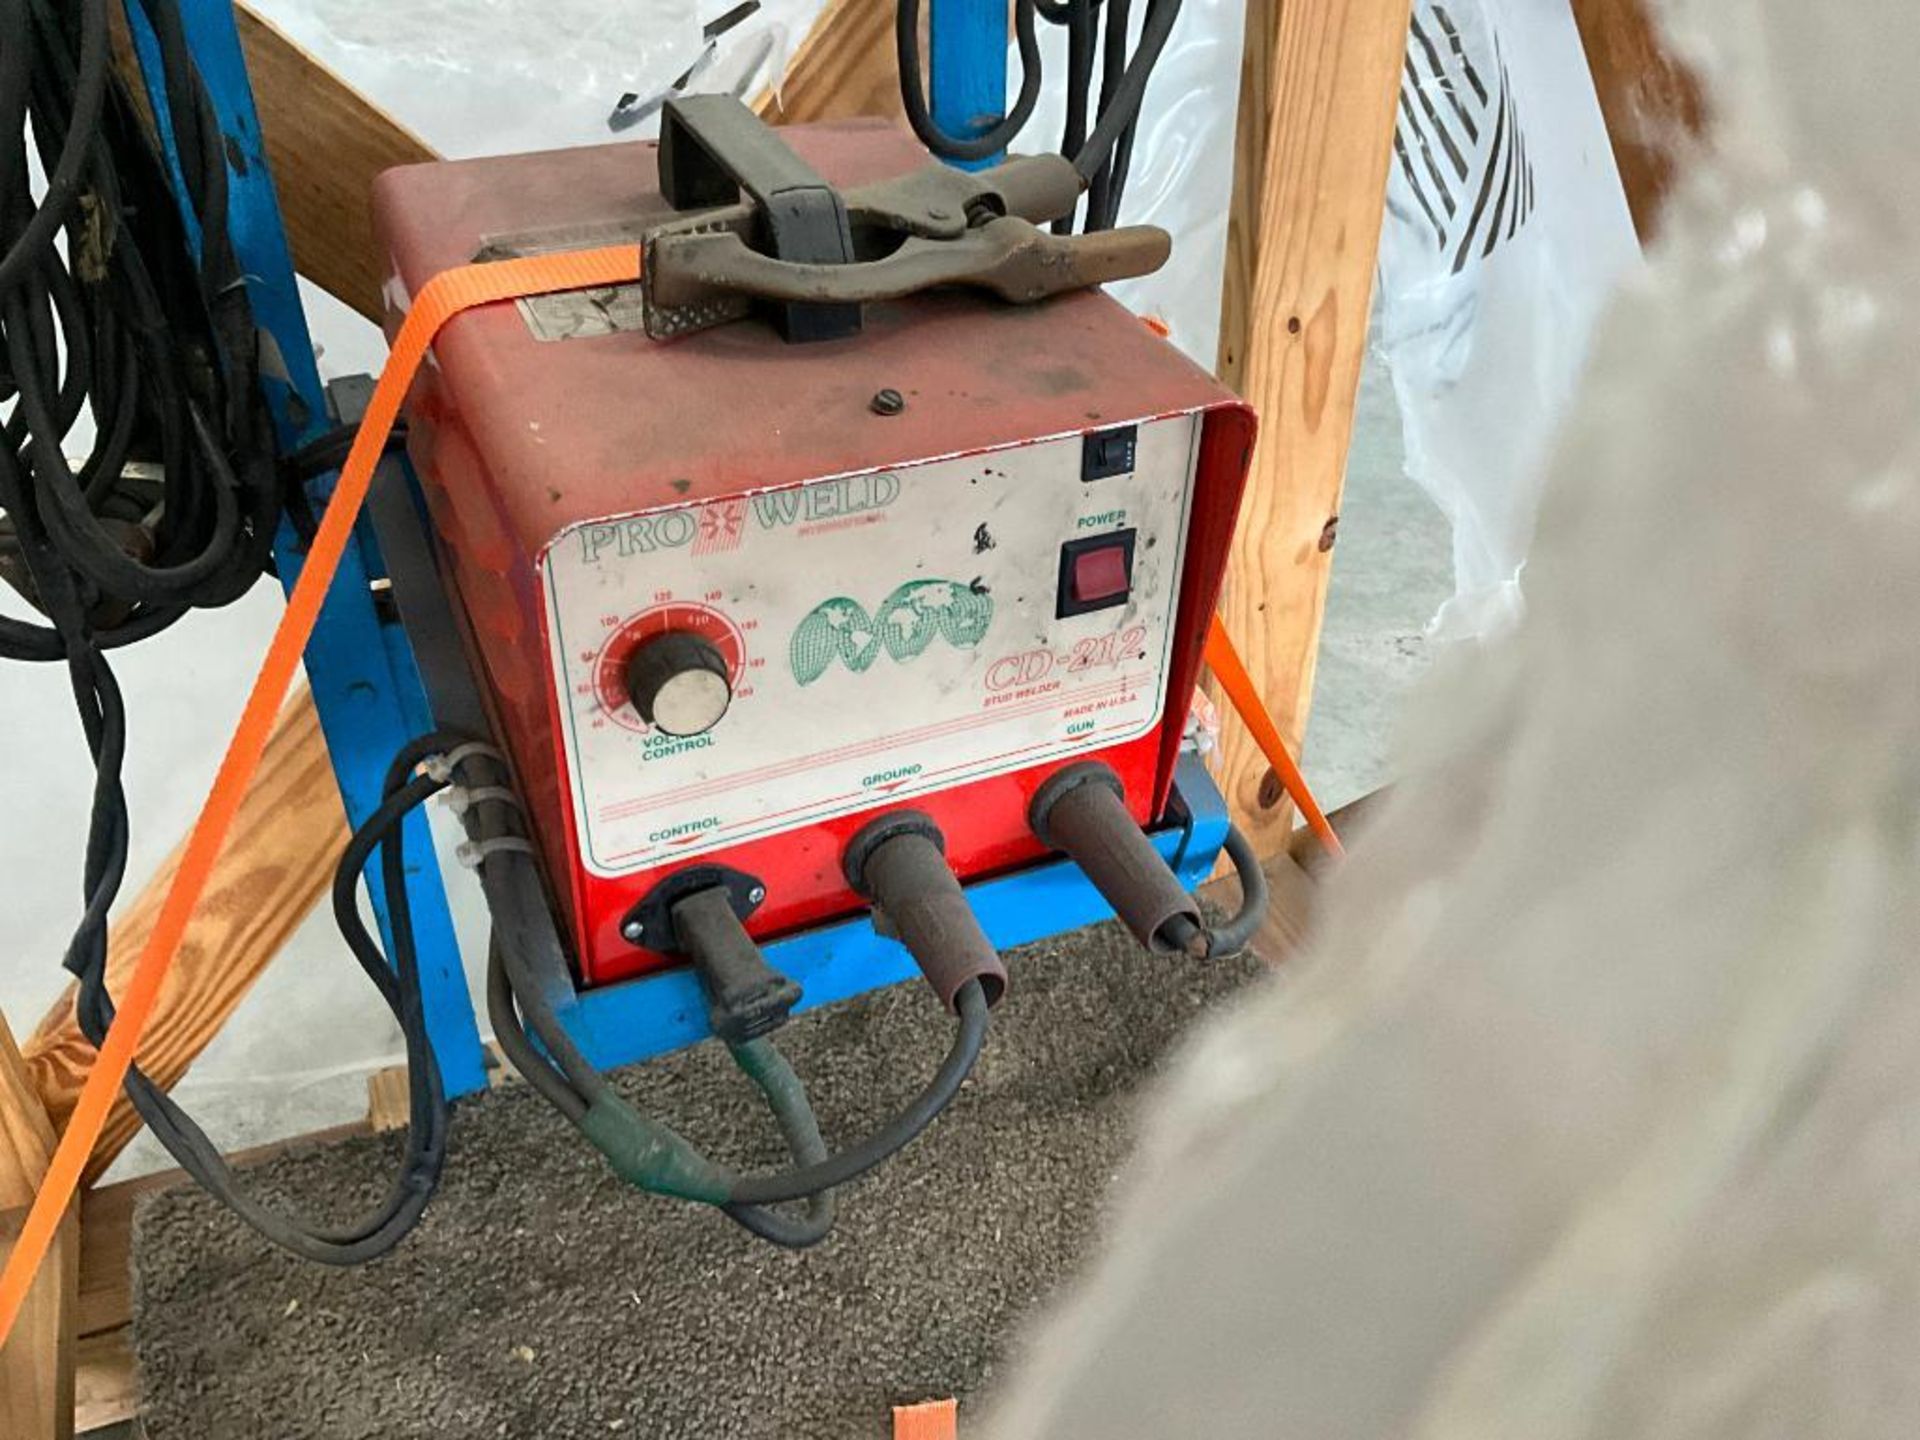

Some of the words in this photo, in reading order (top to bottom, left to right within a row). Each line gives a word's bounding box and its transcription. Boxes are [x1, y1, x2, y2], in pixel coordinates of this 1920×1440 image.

[577, 511, 696, 563] PRO
[752, 474, 900, 530] WELD
[1078, 510, 1126, 528] POWER
[705, 591, 722, 601] 140
[601, 615, 619, 627] 100
[984, 625, 1147, 692] CD-212
[983, 692, 1014, 707] STUD
[1016, 681, 1061, 699] WELDER
[1063, 703, 1094, 718] MADE
[1095, 700, 1108, 711] IN
[1066, 719, 1095, 734] GUN
[642, 735, 716, 762] CONTROL
[862, 763, 922, 788] GROUND
[649, 816, 722, 842] CONTROL
